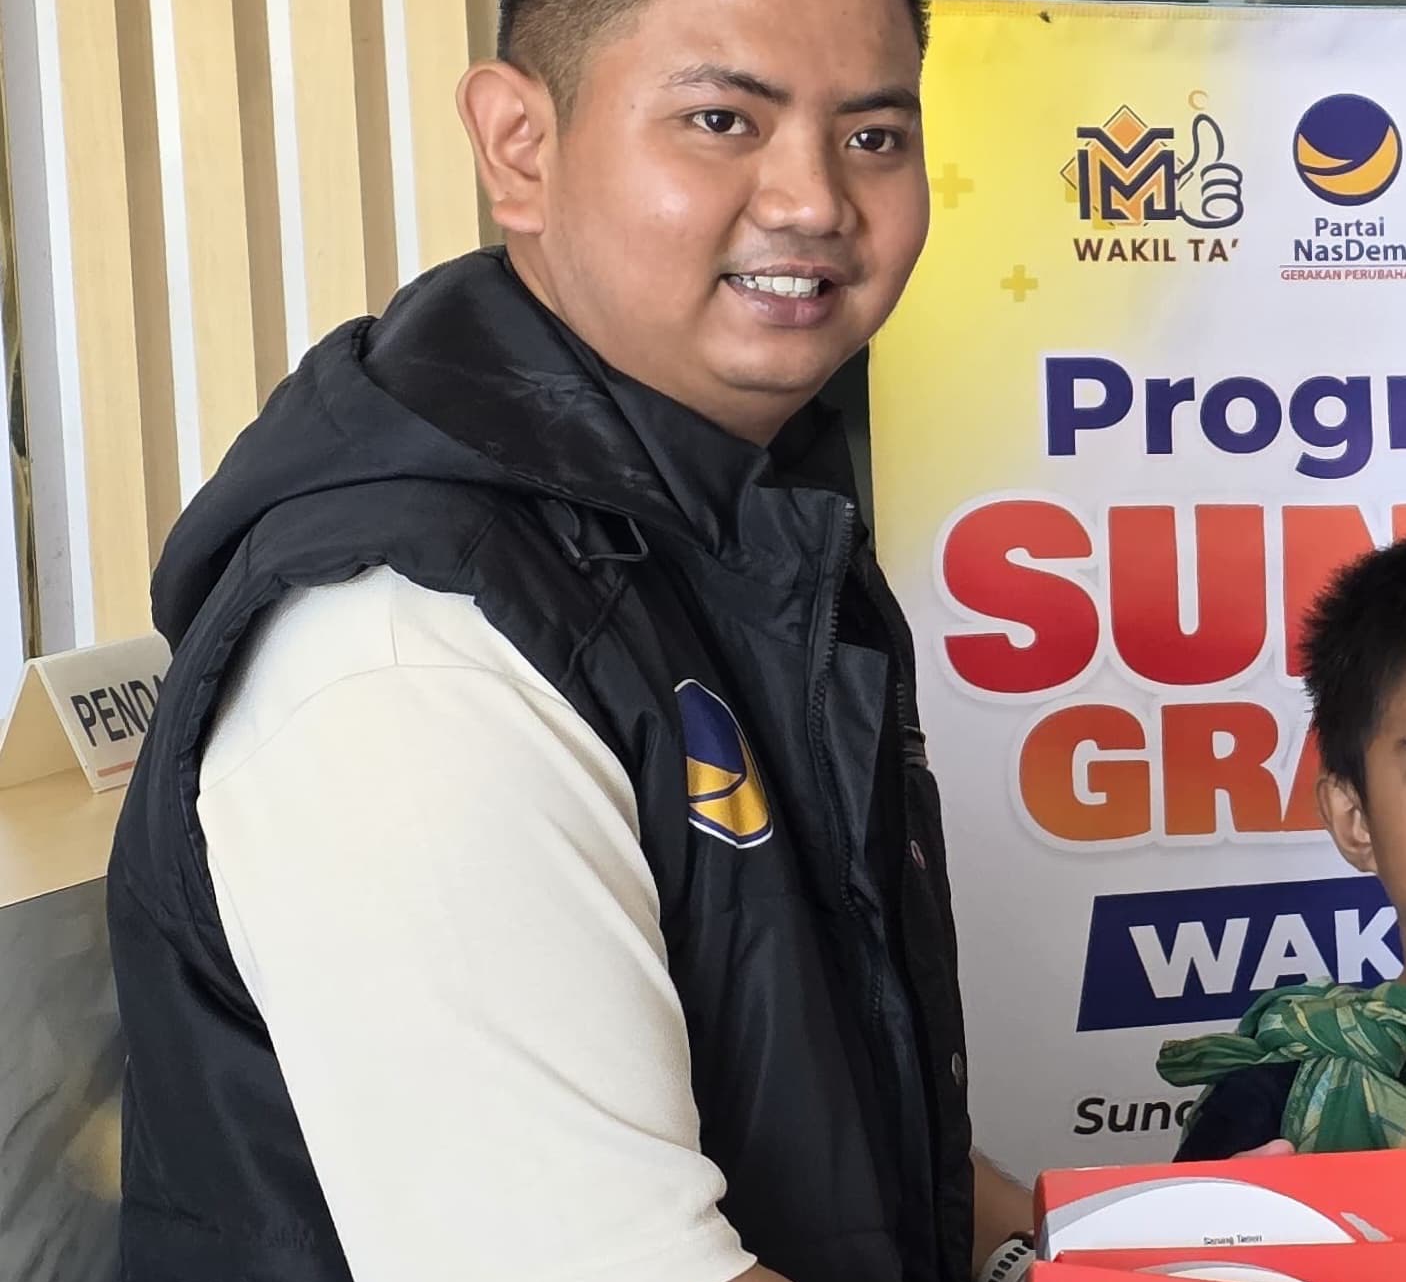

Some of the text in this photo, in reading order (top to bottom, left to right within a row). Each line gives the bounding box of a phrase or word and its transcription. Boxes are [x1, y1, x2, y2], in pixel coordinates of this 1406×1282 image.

[1314, 216, 1385, 237] Partai
[1073, 237, 1176, 262] WAKIL
[1294, 238, 1406, 262] NasDem
[1280, 269, 1342, 281] GERAKAN
[71, 675, 164, 747] PEND
[1128, 905, 1404, 999] WAK
